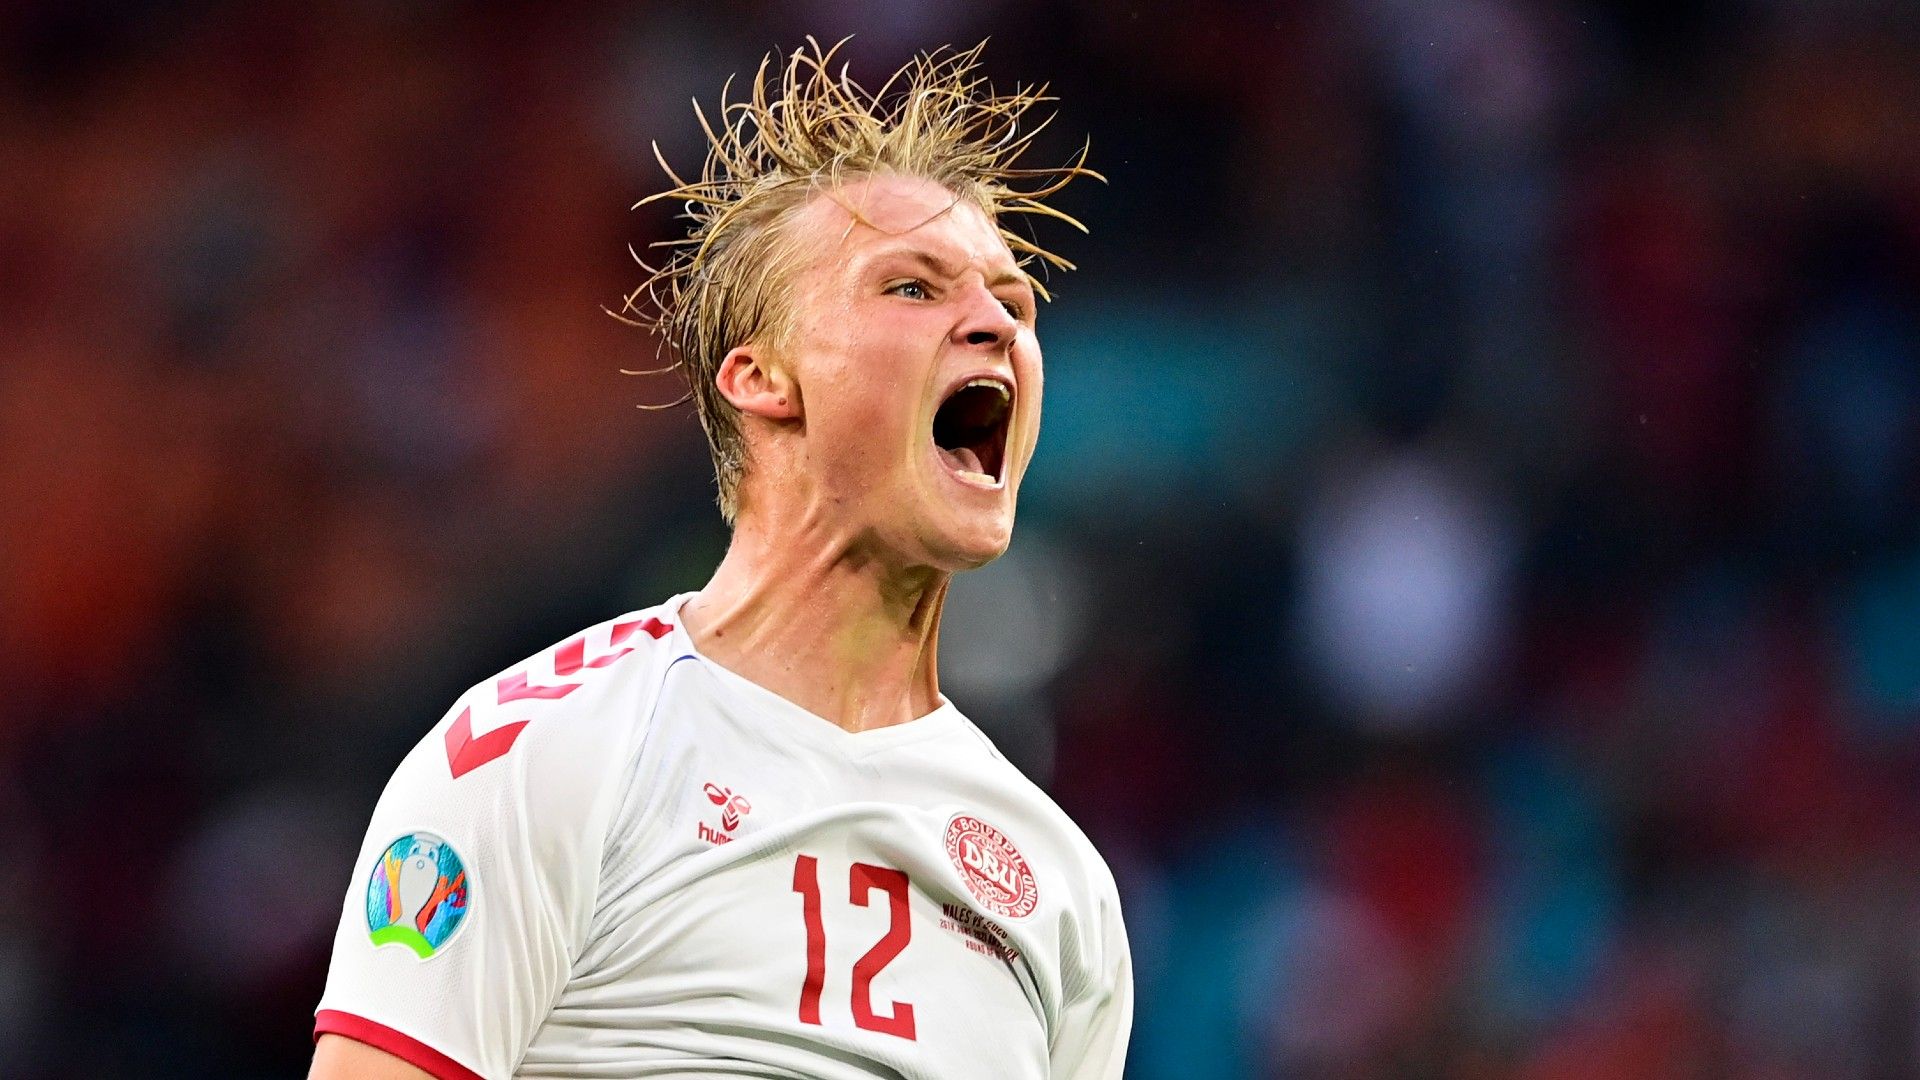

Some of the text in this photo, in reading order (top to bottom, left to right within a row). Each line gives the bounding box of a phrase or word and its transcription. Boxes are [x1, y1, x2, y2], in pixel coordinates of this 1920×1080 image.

[962, 838, 1018, 896] DBU
[942, 902, 972, 924] WALES
[1013, 873, 1038, 917] UNION
[793, 854, 917, 1042] 12
